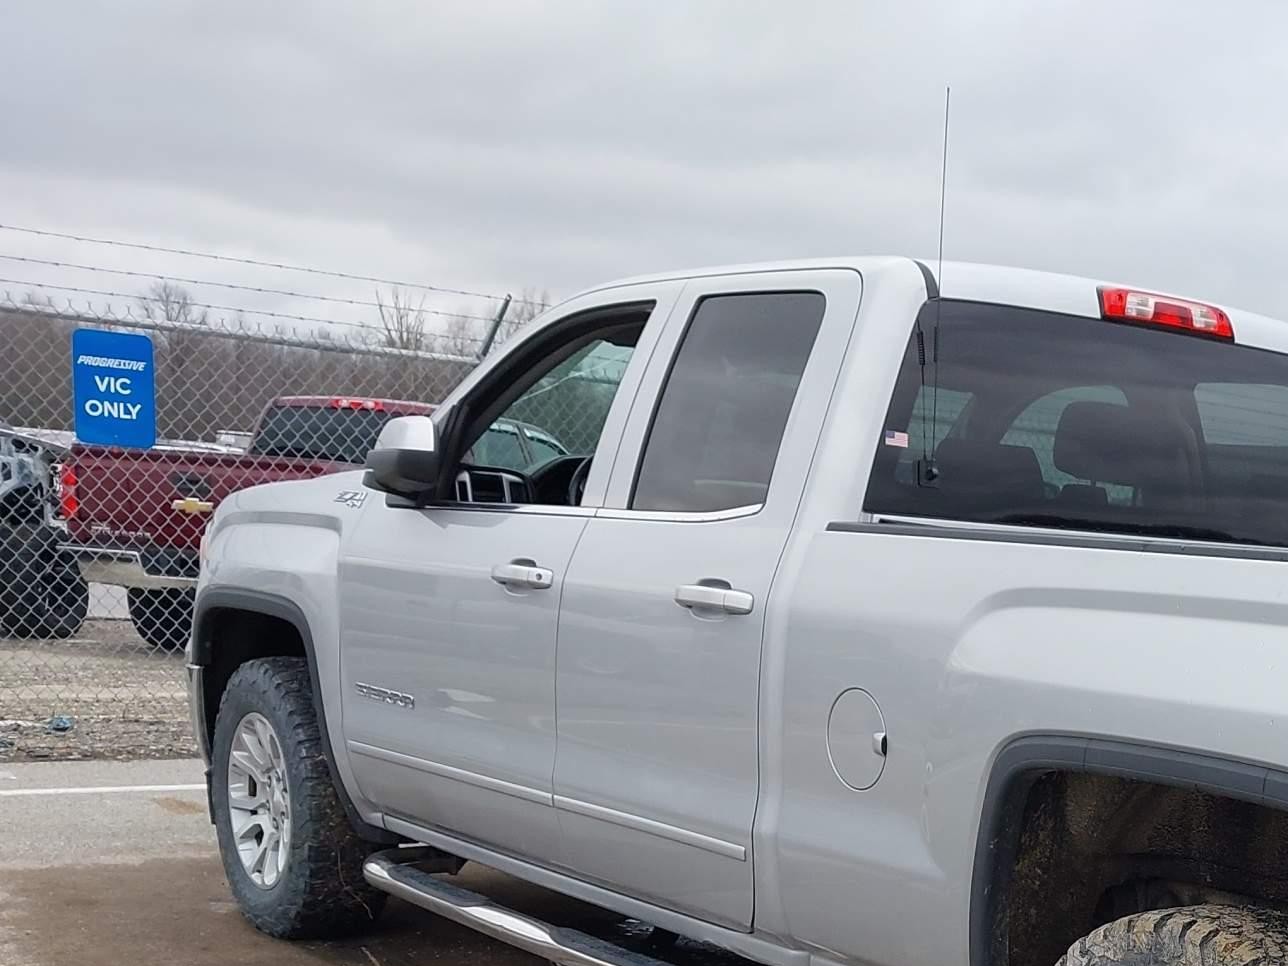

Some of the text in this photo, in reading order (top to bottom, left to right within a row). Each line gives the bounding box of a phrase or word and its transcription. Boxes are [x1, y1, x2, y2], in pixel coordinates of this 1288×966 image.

[77, 355, 147, 371] PROGRESSIVE
[94, 375, 132, 394] VIC
[84, 399, 142, 420] ONLY
